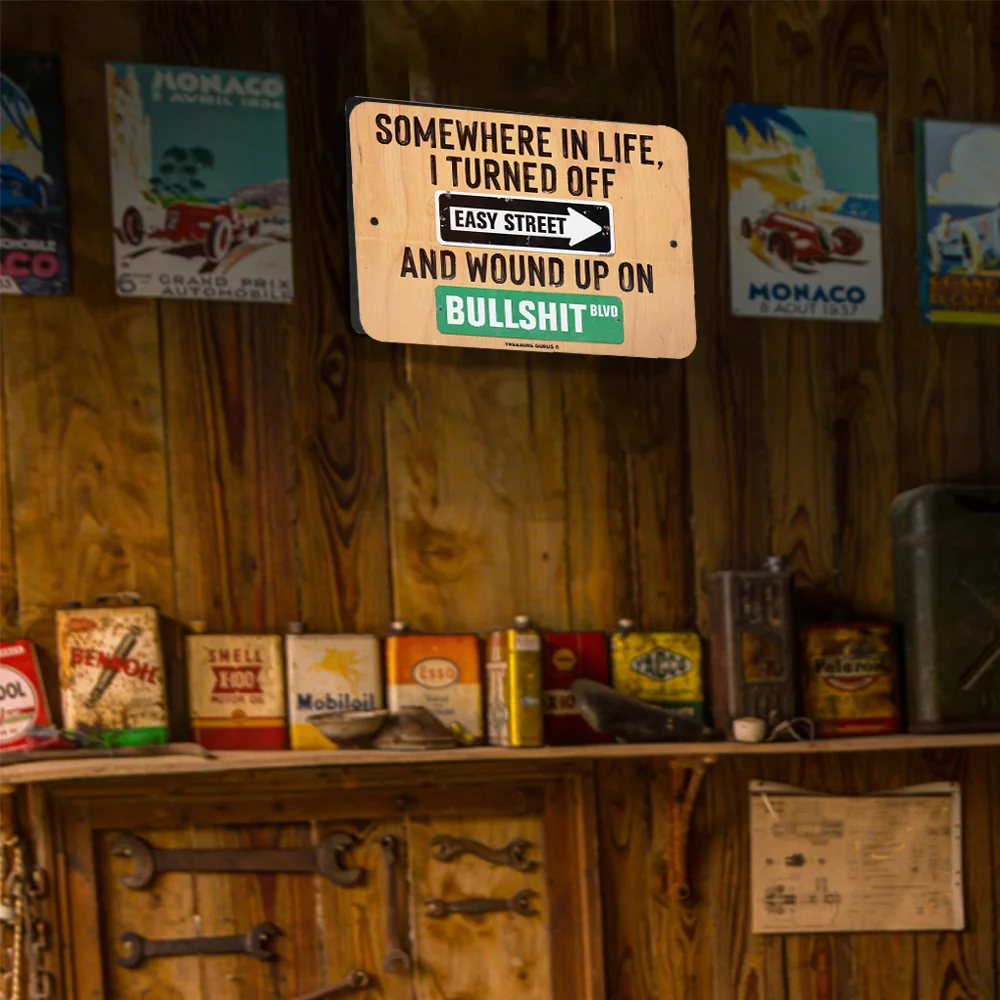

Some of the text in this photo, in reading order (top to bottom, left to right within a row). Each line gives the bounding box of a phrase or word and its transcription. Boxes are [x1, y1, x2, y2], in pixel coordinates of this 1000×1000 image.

[150, 69, 285, 99] MONACO
[375, 113, 664, 171] SOMEWHERE IN LIFE,
[430, 155, 616, 199] I TURNED OFF
[454, 209, 567, 236] EASY STREET
[158, 273, 229, 288] GRAND
[240, 277, 290, 290] PRIX
[400, 247, 655, 294] AND WOUND UP ON
[749, 282, 866, 304] MONACO
[445, 295, 619, 333] BULLSHIT BLVD
[208, 649, 263, 663] SHELL
[297, 693, 377, 711] Mobiloil
